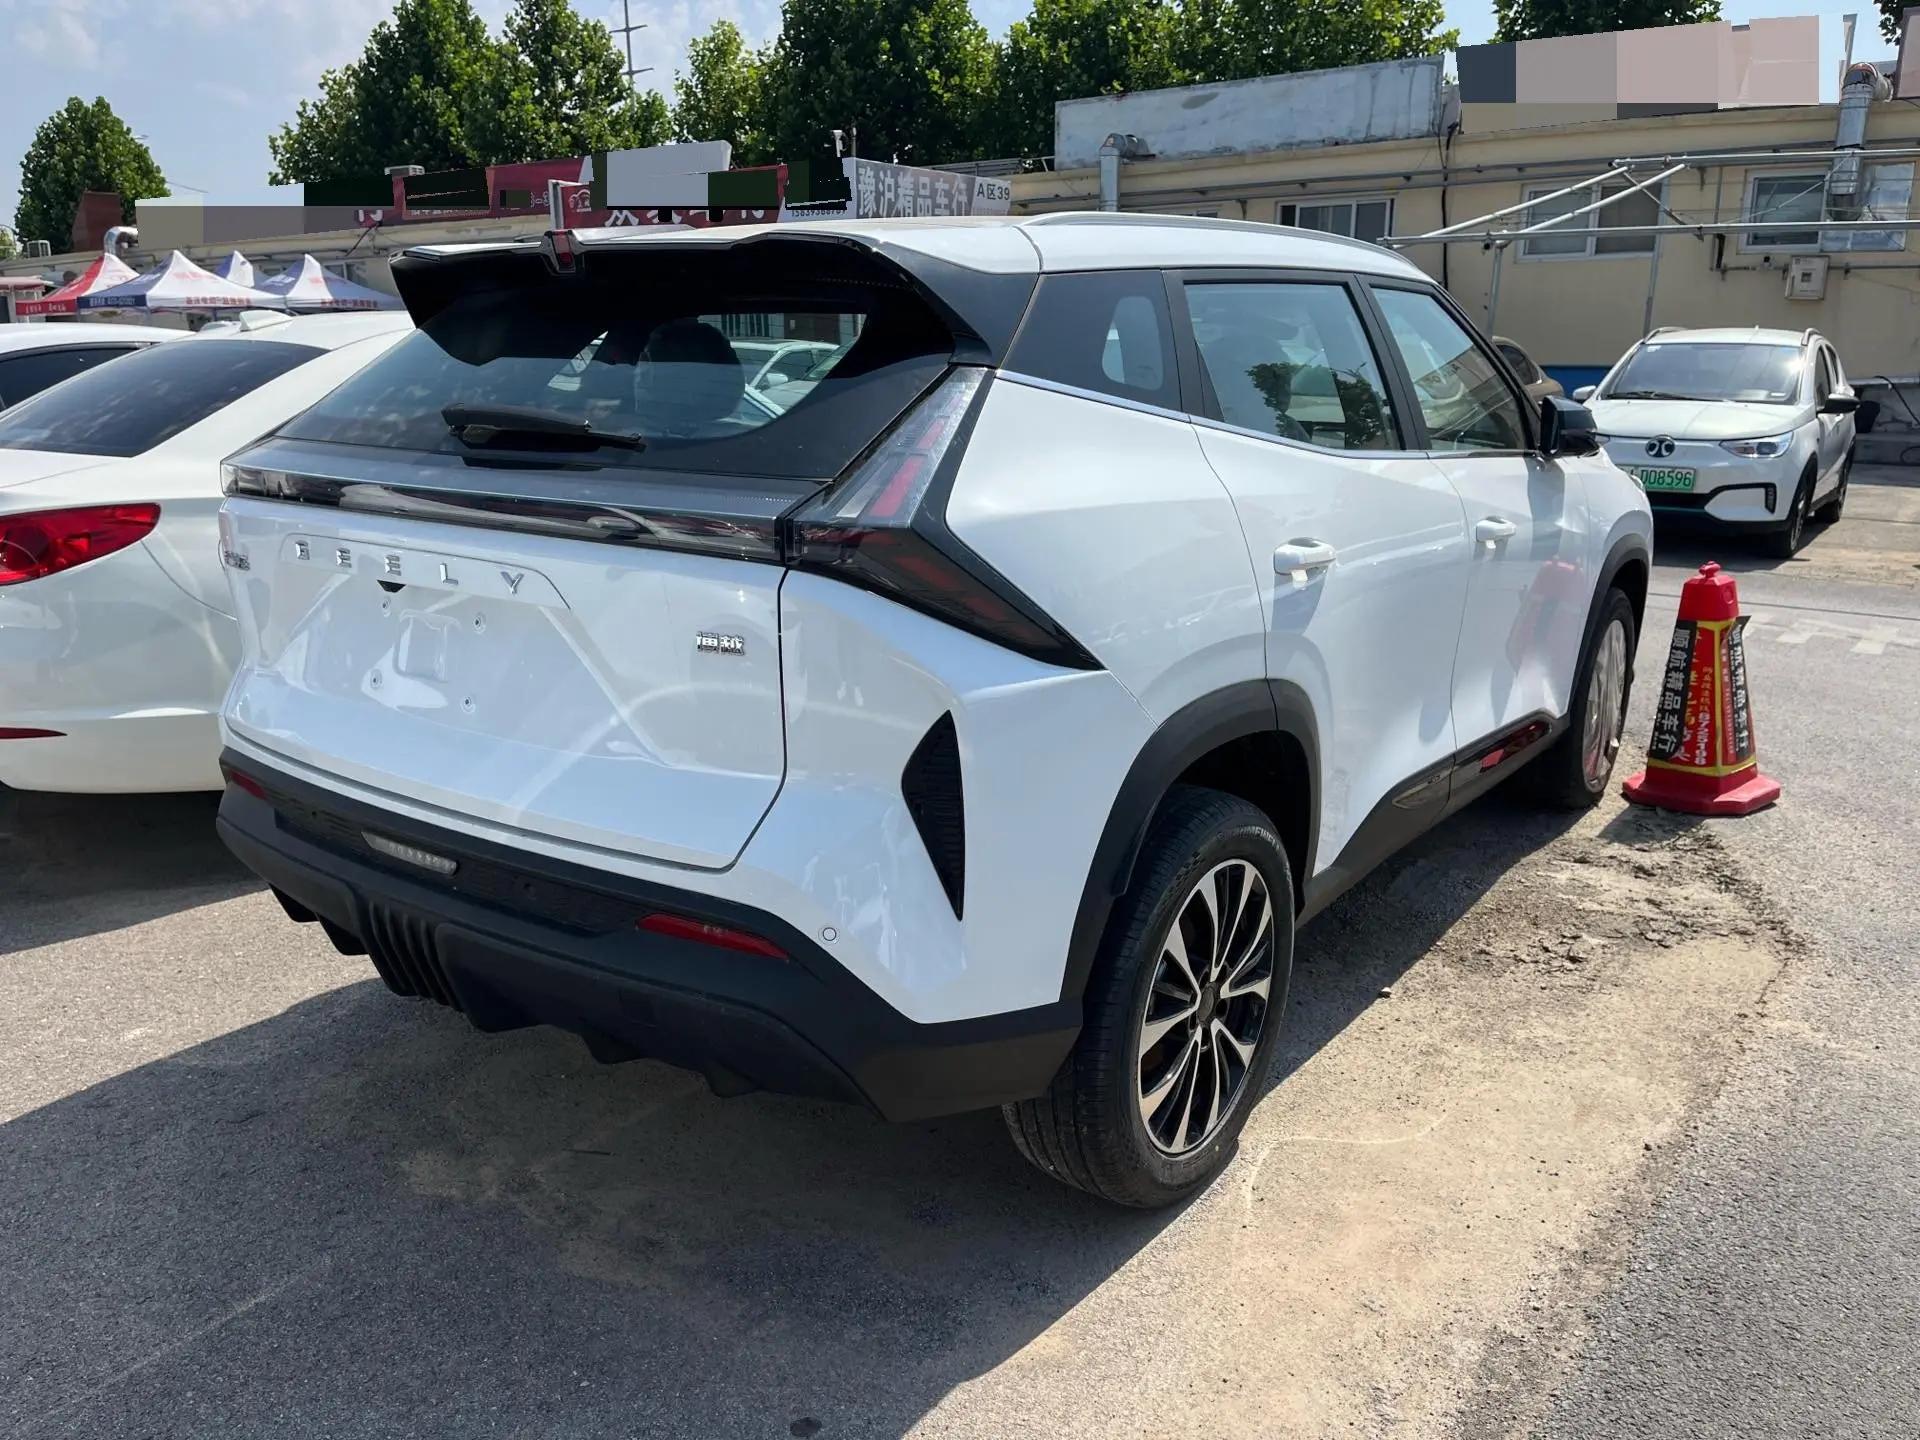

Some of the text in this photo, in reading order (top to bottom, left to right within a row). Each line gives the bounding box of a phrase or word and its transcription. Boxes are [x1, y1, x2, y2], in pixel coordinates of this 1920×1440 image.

[976, 182, 1010, 200] A区39
[1630, 469, 1692, 487] D08596
[295, 540, 524, 595] GEELY
[1658, 627, 1690, 754] 顺航精品车行
